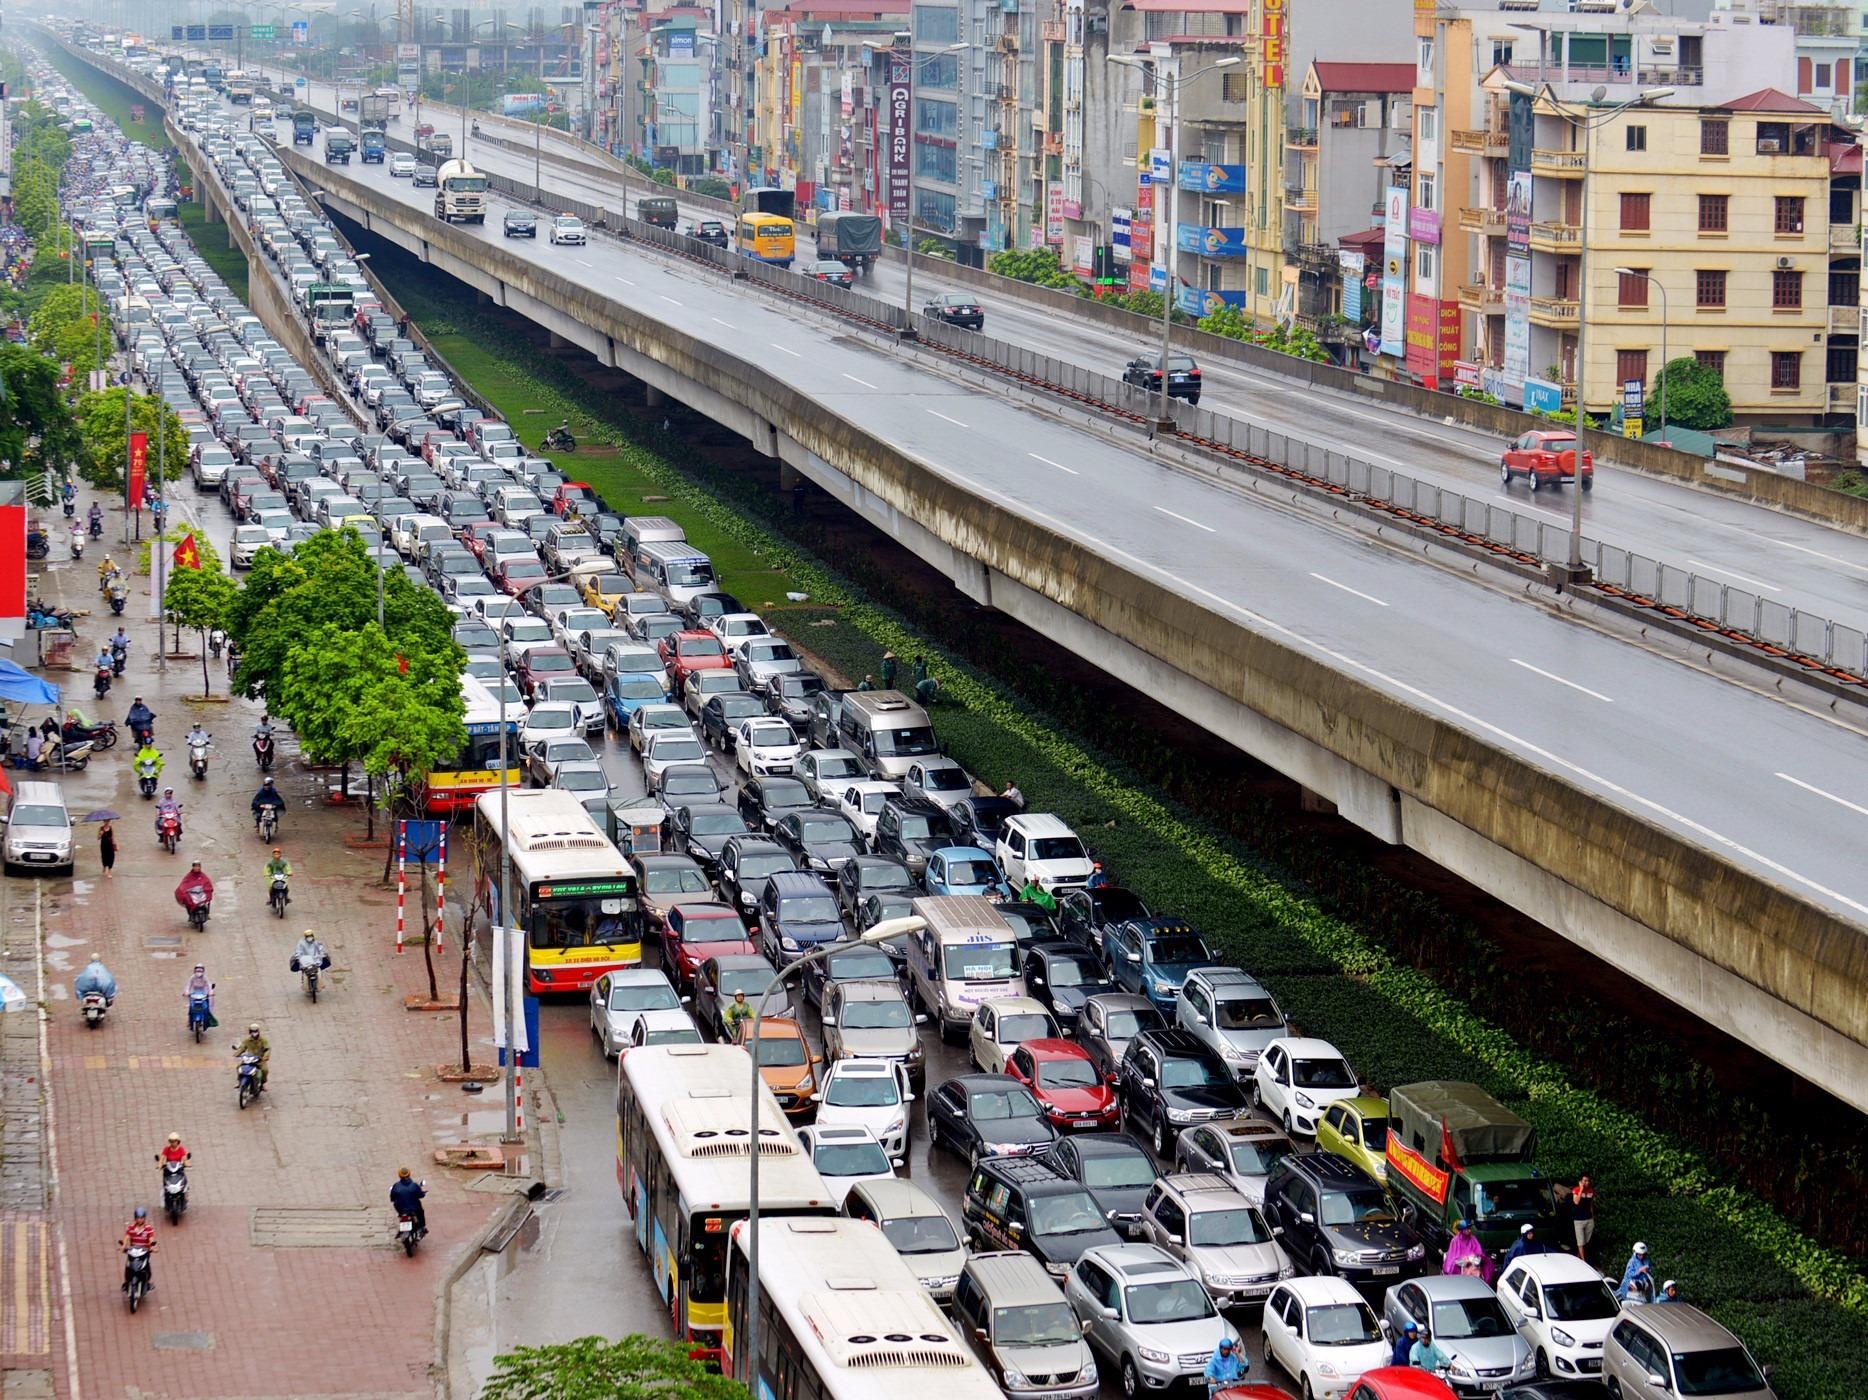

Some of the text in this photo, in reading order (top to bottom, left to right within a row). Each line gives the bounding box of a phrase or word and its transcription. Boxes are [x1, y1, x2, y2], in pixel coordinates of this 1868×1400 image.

[671, 35, 692, 44] simon
[892, 88, 908, 163] AGRIBANK
[1440, 309, 1456, 319] DỊCH
